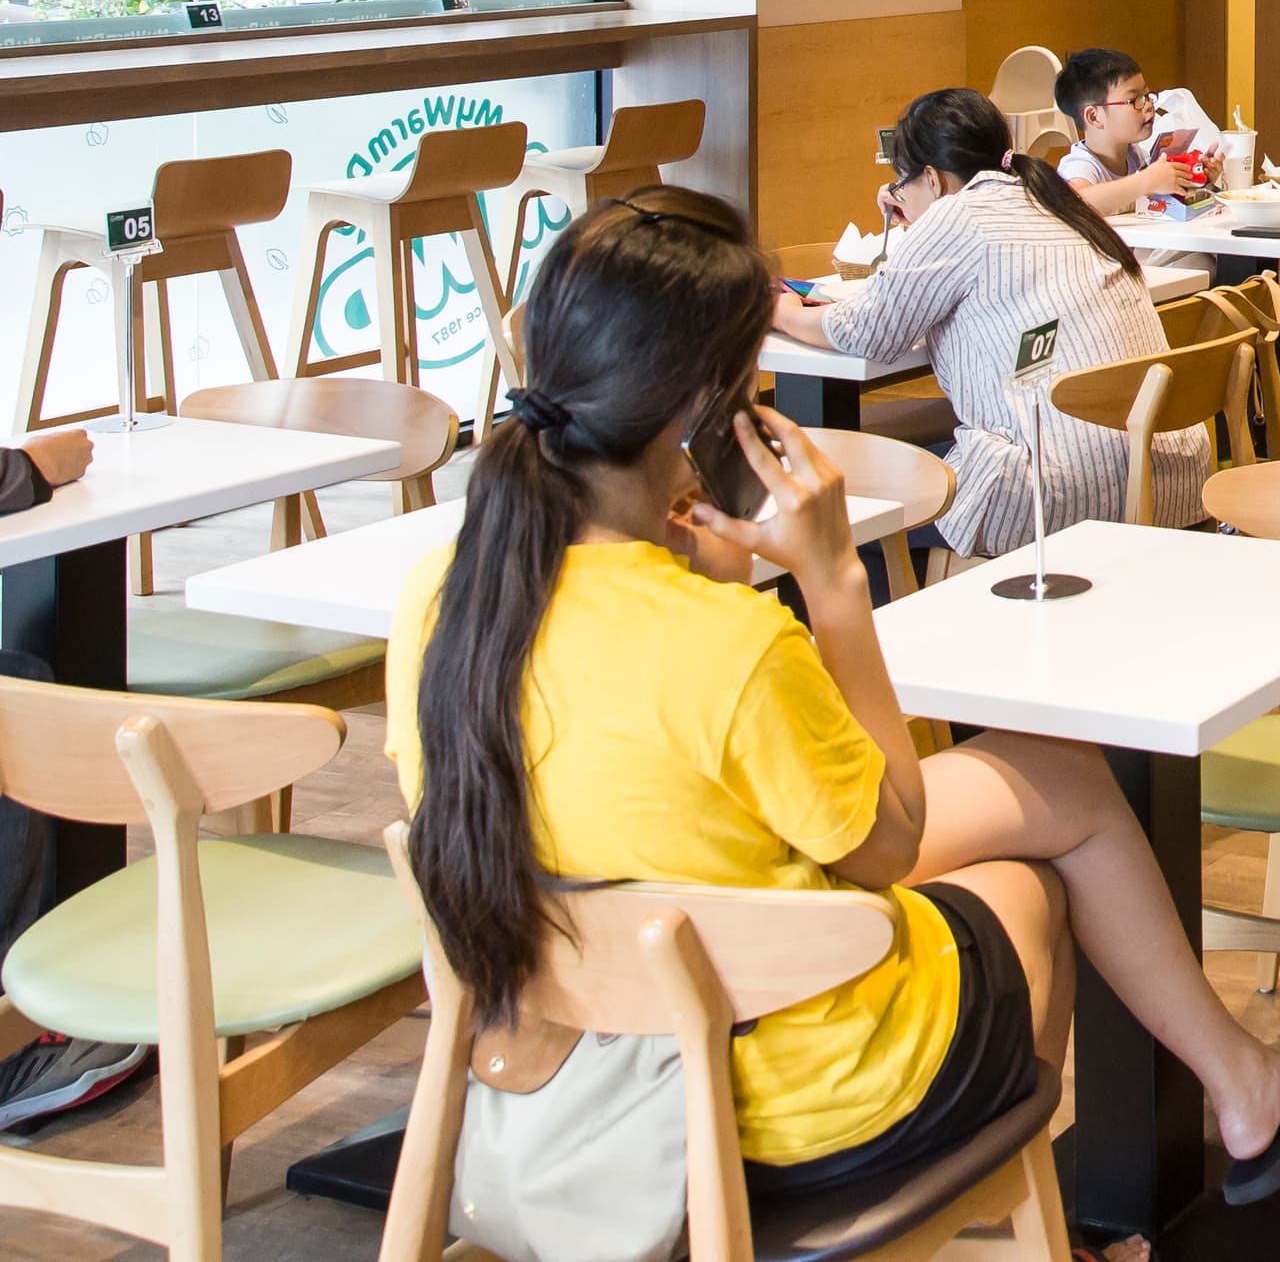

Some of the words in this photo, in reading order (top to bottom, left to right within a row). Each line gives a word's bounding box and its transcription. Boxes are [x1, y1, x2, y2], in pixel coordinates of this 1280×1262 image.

[200, 8, 219, 22] 13
[124, 215, 150, 240] 05
[1031, 329, 1056, 360] 07
